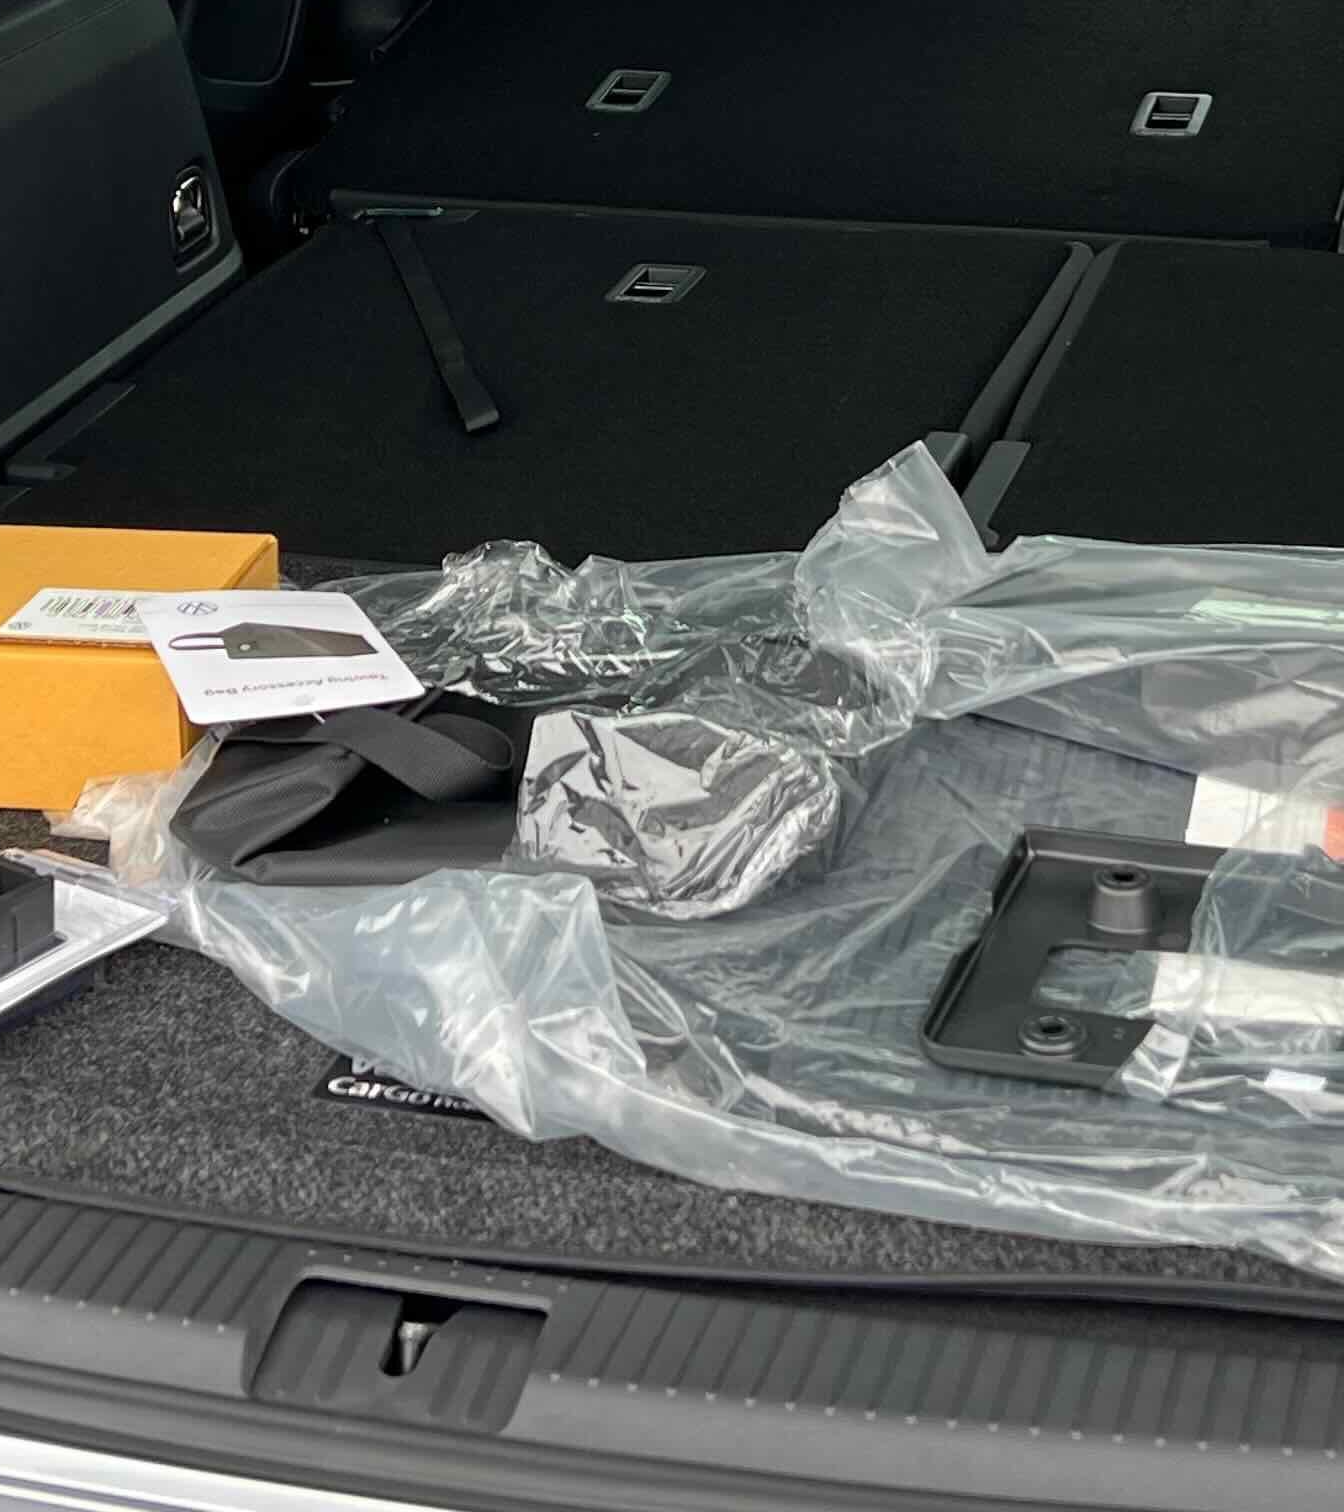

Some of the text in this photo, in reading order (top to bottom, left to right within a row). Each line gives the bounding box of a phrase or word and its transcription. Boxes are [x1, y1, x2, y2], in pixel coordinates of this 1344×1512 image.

[203, 673, 389, 698] Towing Accessory Bag
